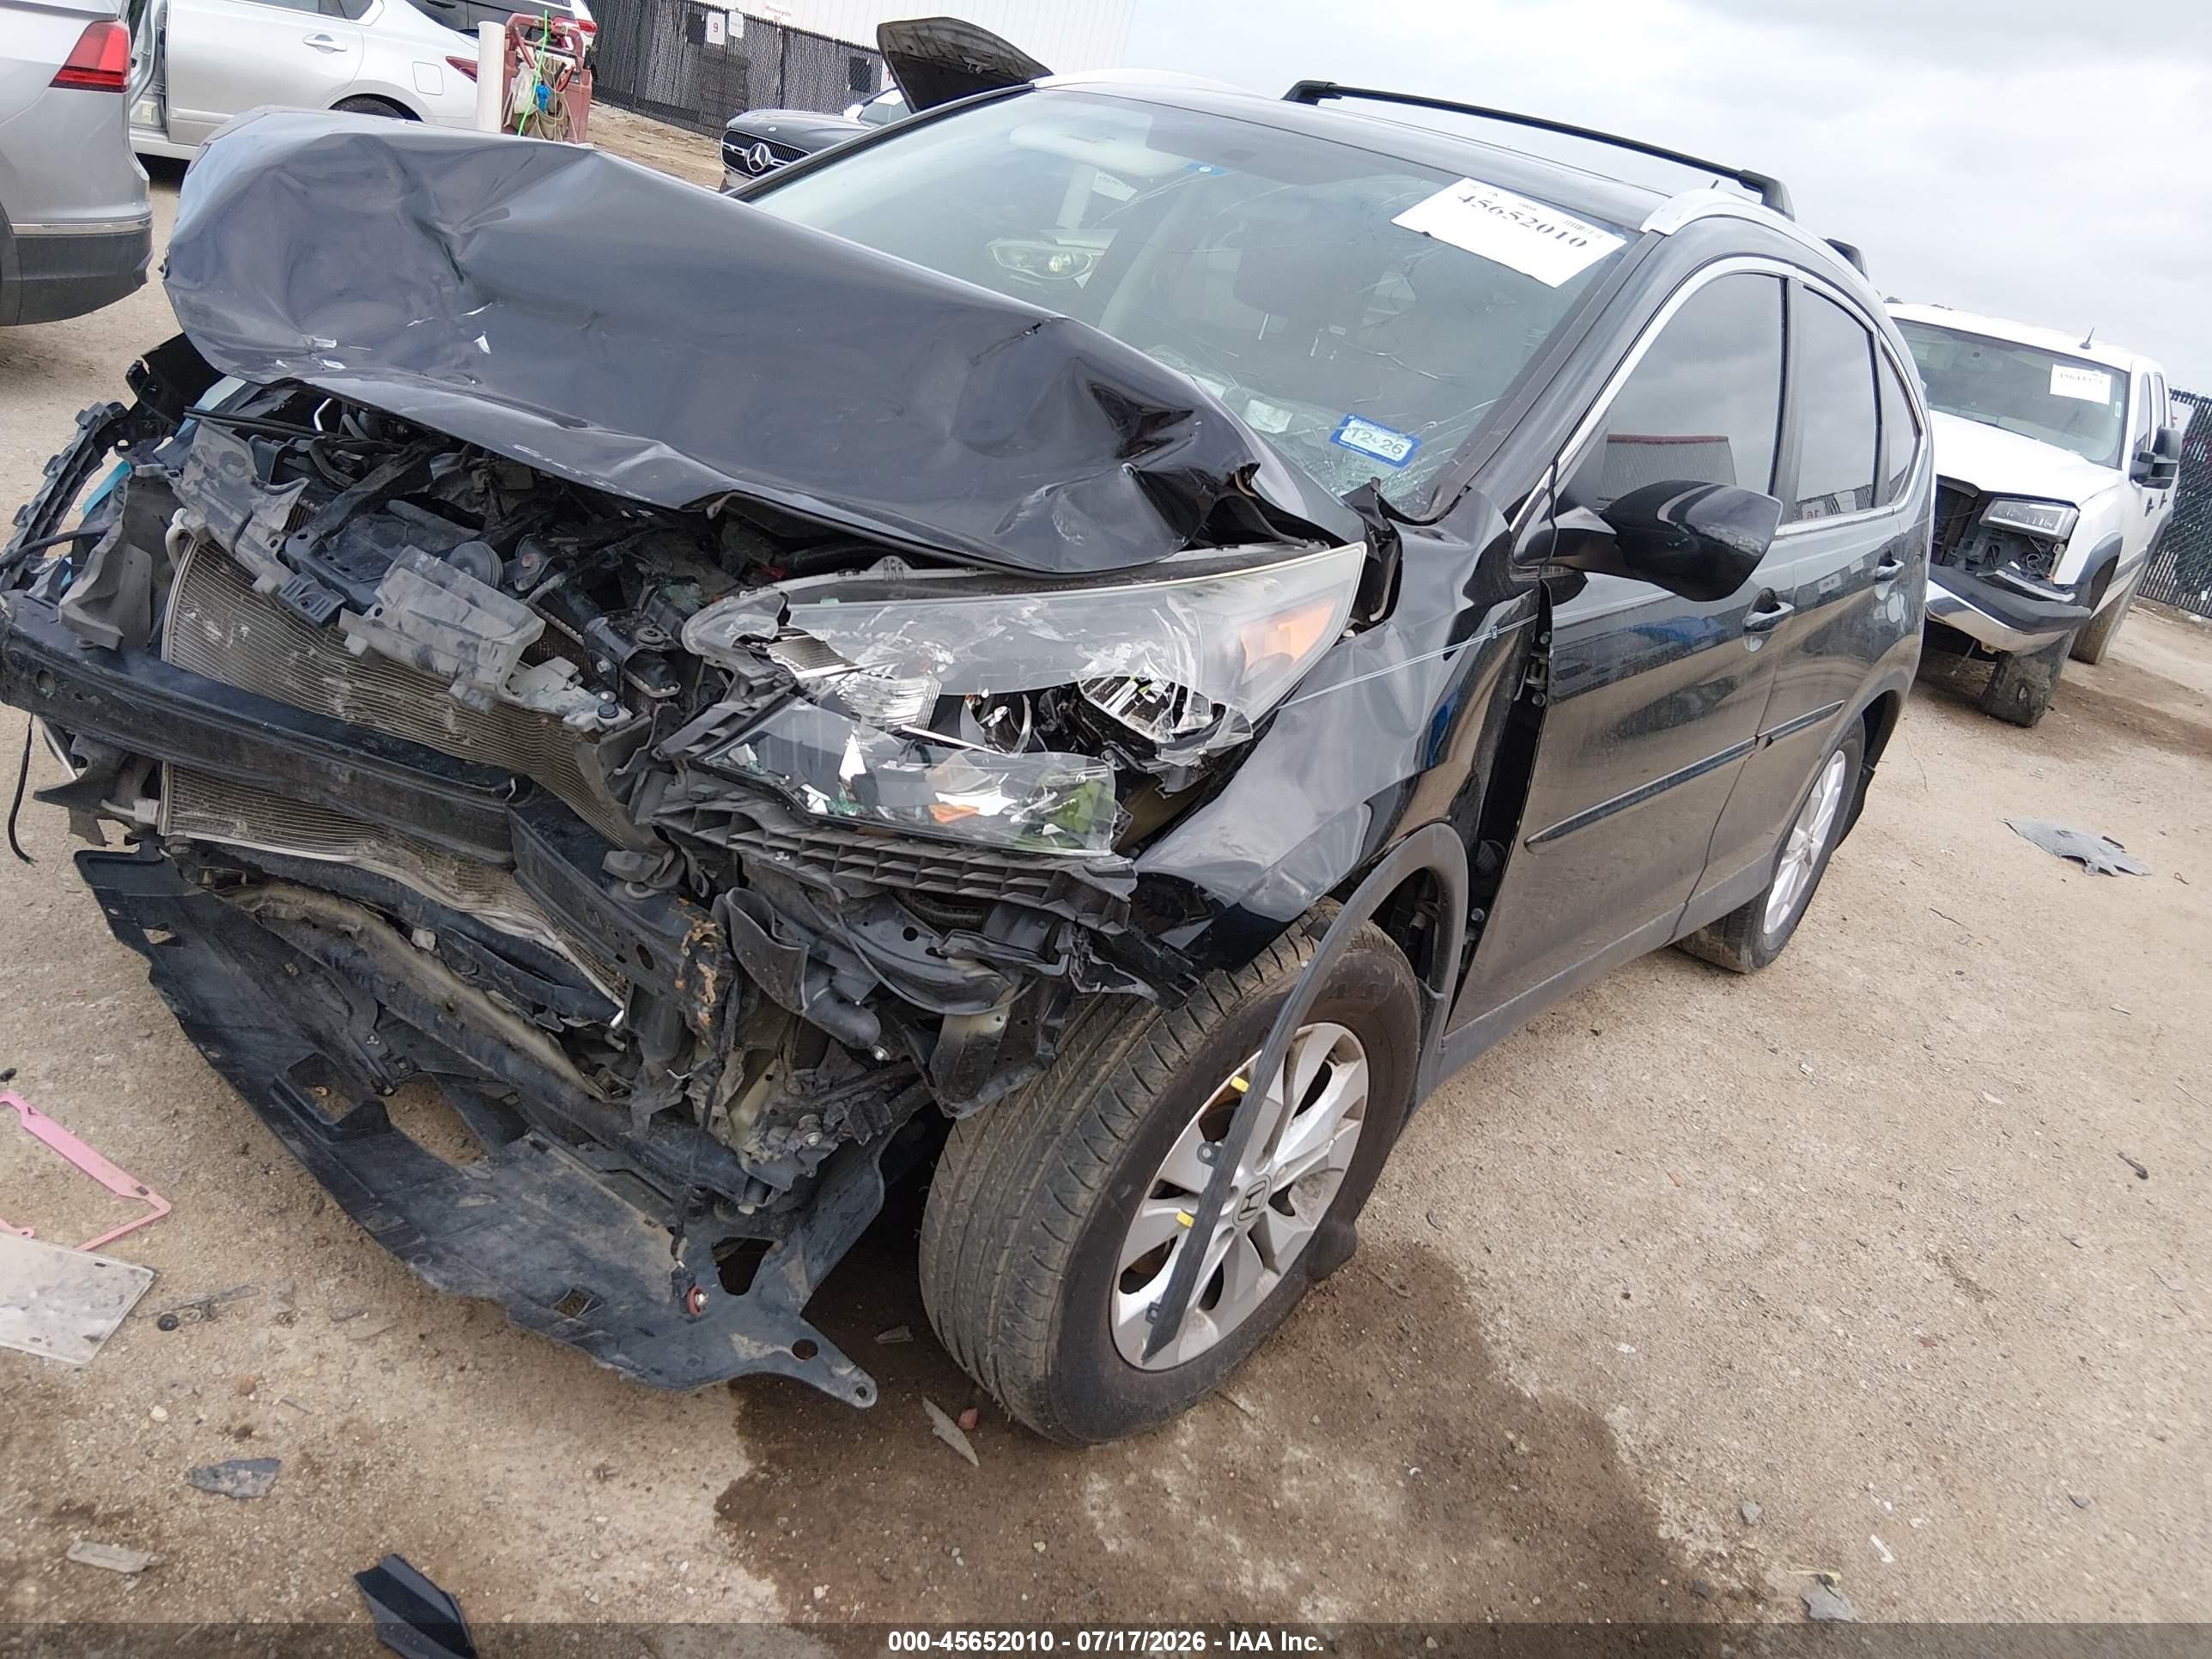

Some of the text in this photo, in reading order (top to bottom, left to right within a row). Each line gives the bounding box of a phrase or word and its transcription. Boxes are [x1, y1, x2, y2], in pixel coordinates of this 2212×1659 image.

[713, 22, 719, 33] 9
[1457, 195, 1588, 247] 45652010
[1379, 439, 1405, 455] 26
